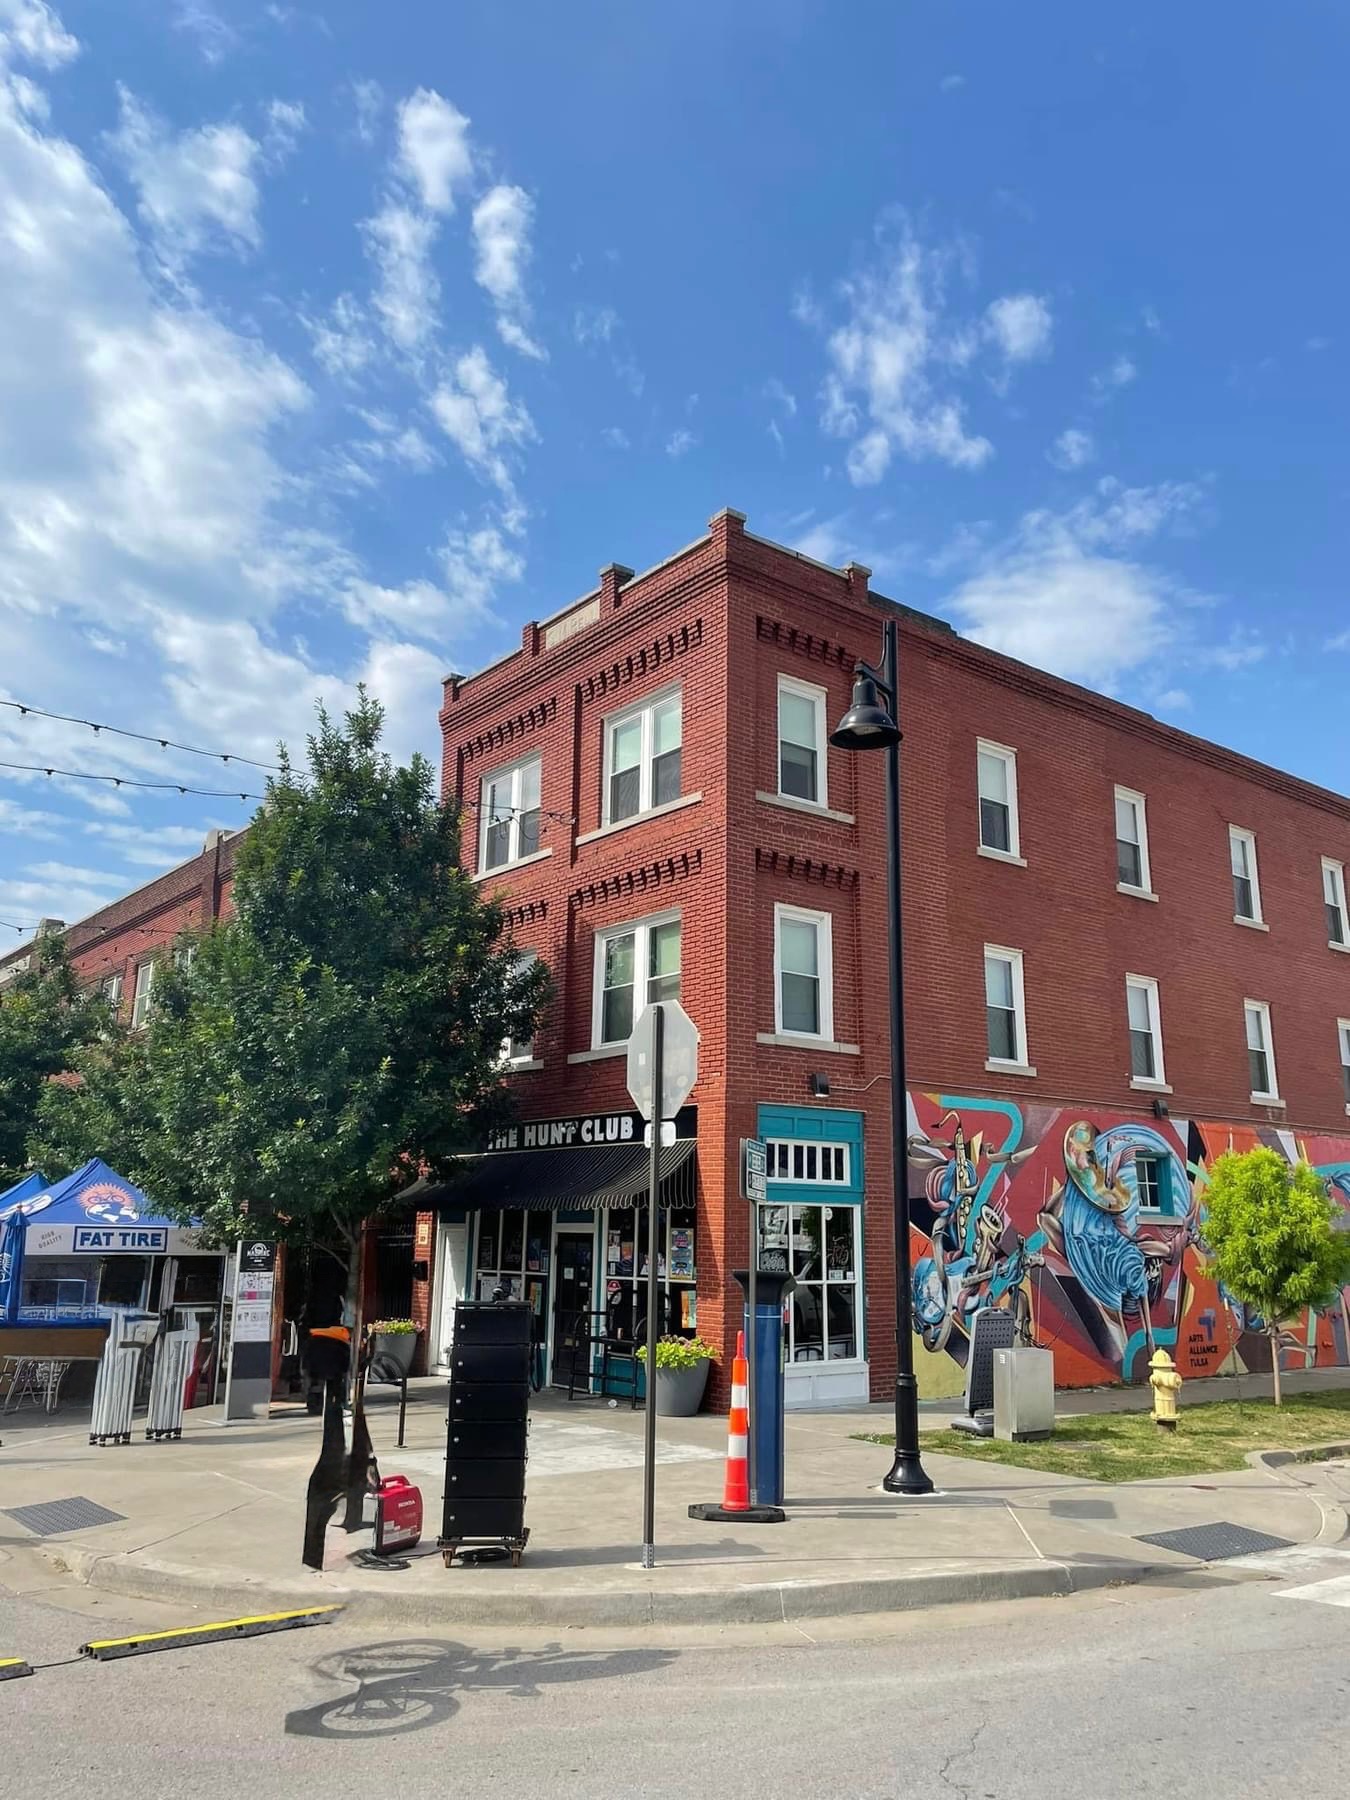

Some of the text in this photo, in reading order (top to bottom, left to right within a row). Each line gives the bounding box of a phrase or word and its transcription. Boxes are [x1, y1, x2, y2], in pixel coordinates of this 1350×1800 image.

[524, 1121, 579, 1147] HUNT
[581, 1116, 634, 1143] CLUB
[79, 1232, 162, 1247] FAT TIRE
[1189, 1334, 1204, 1343] ARTS
[1189, 1344, 1218, 1355] ALLIANCE
[1190, 1357, 1209, 1367] TULSA
